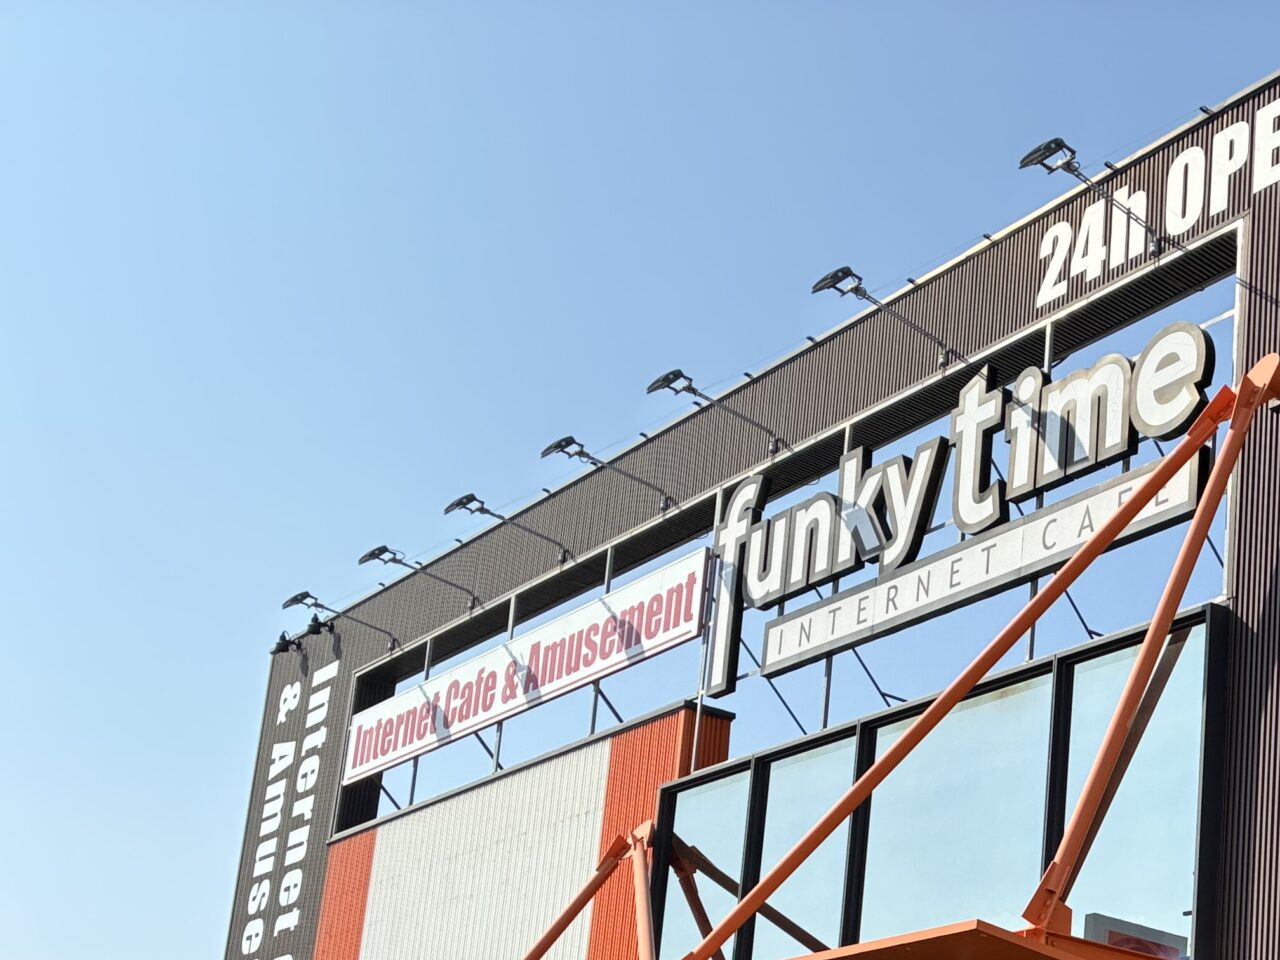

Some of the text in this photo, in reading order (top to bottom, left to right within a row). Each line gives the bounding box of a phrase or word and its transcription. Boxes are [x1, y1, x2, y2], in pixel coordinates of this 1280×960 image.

[1037, 184, 1148, 309] 24h
[706, 321, 1210, 698] funky time
[351, 570, 697, 769] Internet Cafe & Amusement
[778, 543, 997, 656] INTERNET
[276, 681, 301, 726] &
[273, 660, 340, 937] Internet
